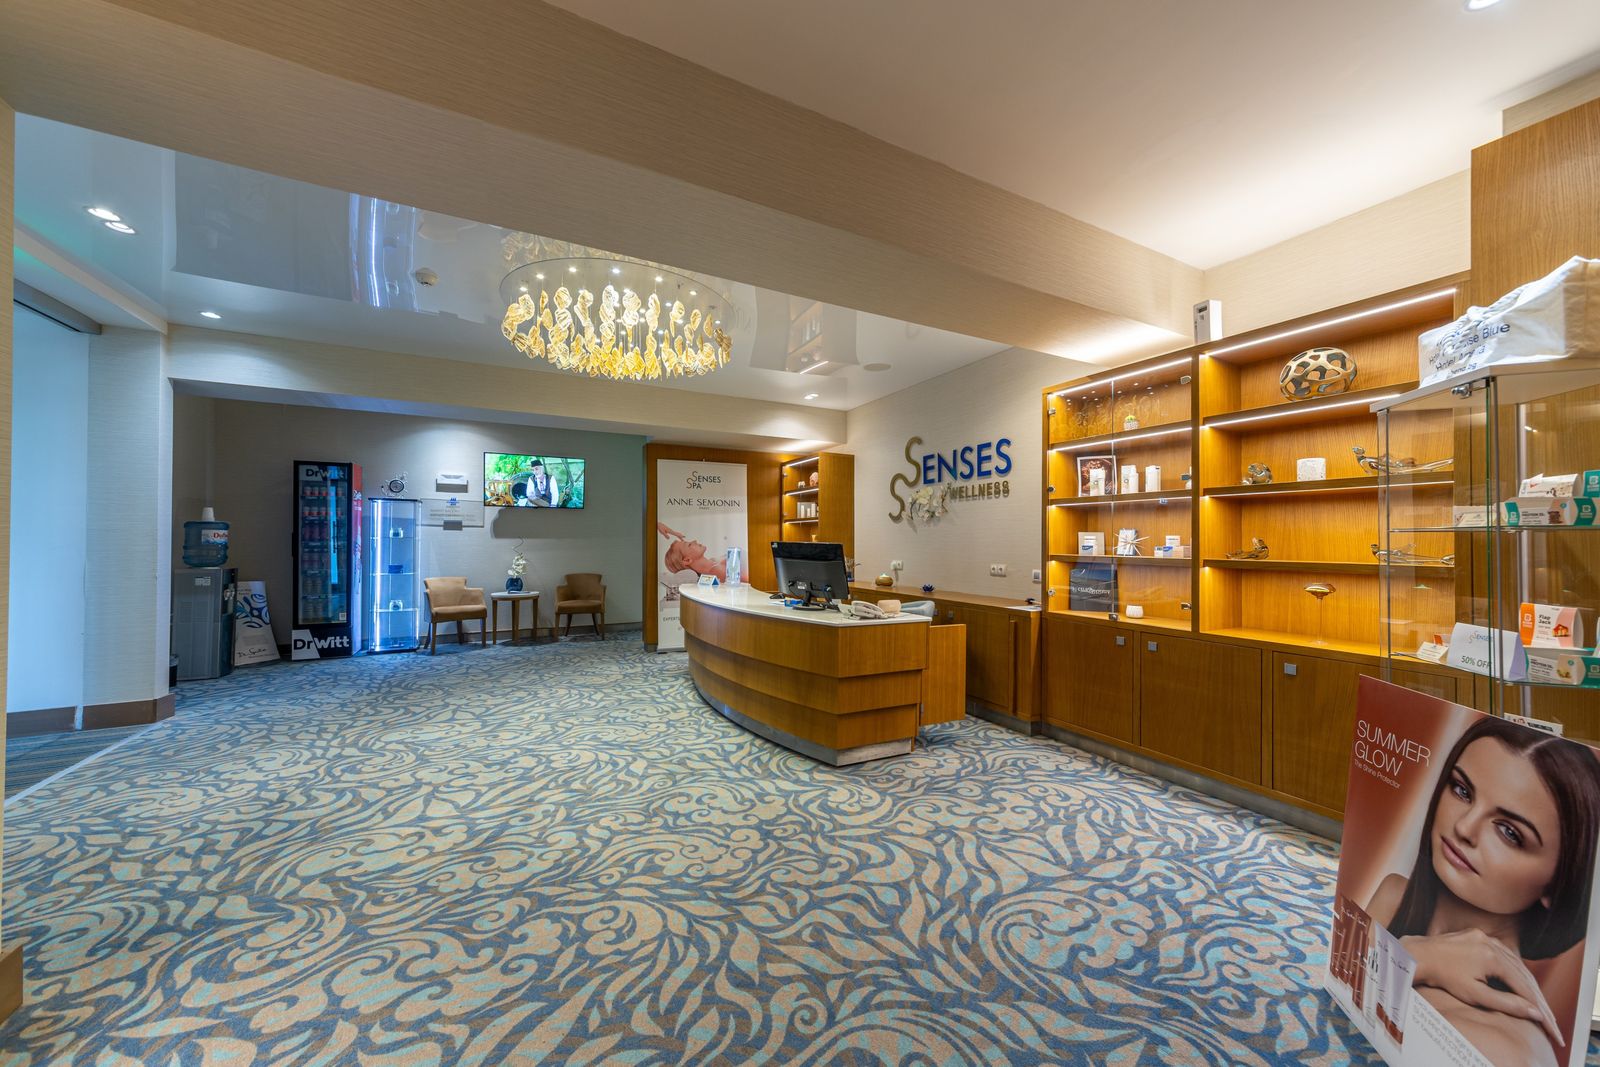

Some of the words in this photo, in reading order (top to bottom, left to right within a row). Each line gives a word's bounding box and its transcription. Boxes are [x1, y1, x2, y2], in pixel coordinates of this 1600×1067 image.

[1482, 324, 1510, 339] Blue
[905, 436, 1012, 488] SENSES
[691, 471, 721, 483] SENSES
[949, 480, 1009, 499] WELLNESS
[666, 498, 694, 506] ANNE
[696, 499, 740, 507] SEMONIN
[293, 636, 349, 650] DrWitt
[1461, 655, 1476, 666] 50%
[1357, 720, 1431, 767] SUMMER
[1354, 740, 1403, 776] GLOW
